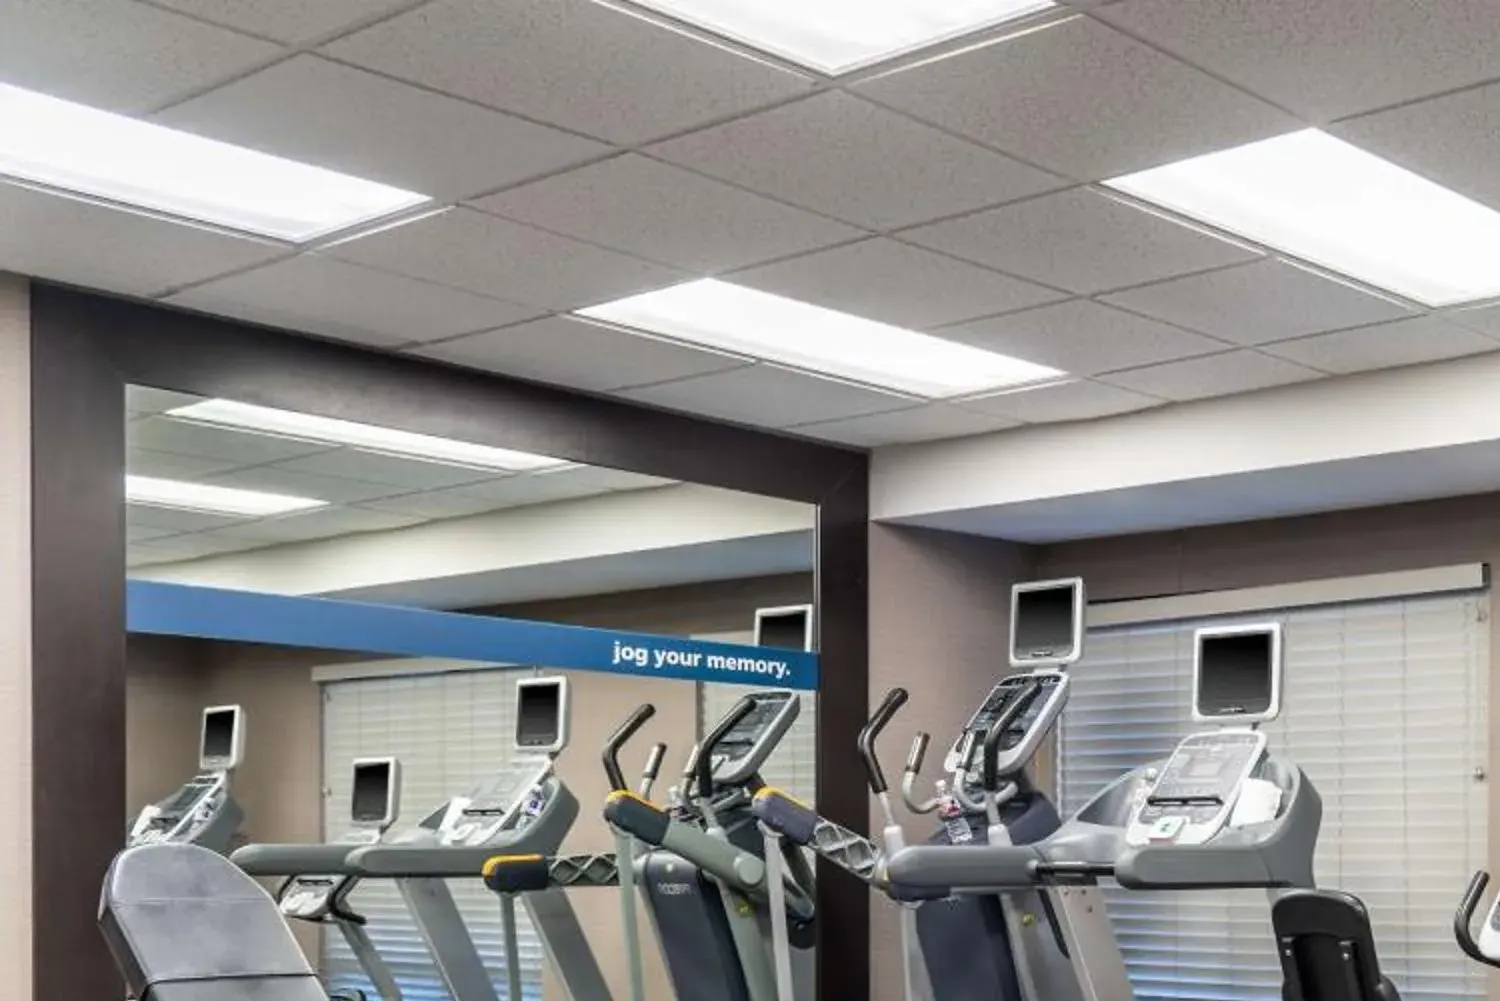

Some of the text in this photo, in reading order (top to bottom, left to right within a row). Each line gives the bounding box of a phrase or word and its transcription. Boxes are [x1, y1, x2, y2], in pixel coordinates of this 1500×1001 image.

[612, 640, 791, 678] jog your memory.
